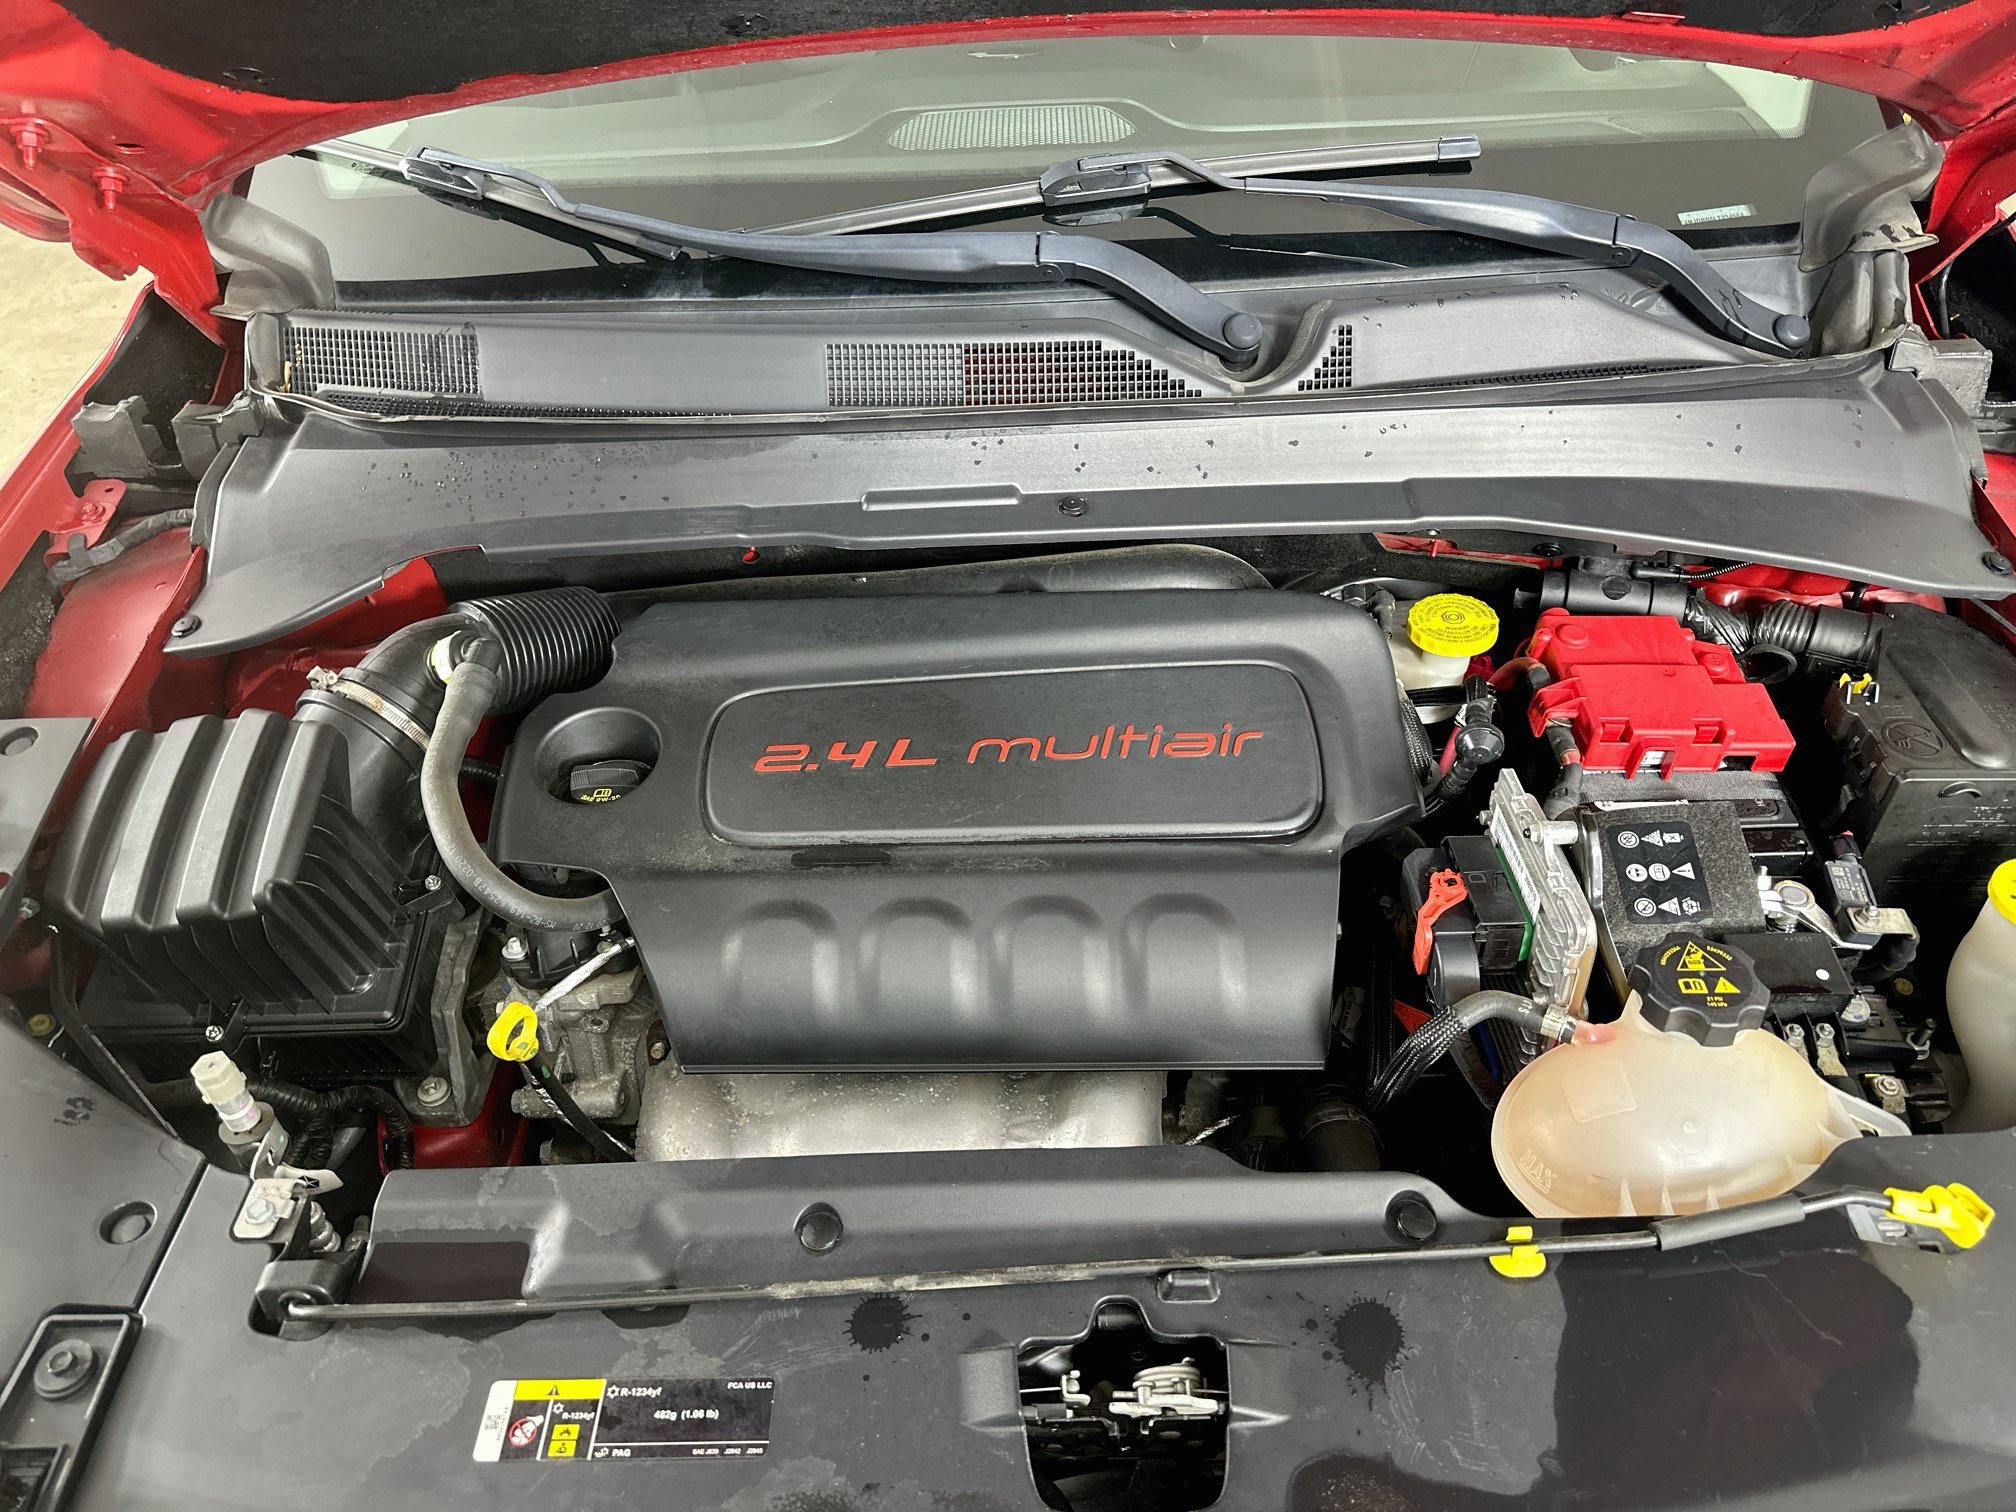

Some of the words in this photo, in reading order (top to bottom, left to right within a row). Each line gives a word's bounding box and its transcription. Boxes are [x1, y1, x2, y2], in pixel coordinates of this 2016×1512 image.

[968, 723, 1264, 763] multiair
[580, 794, 595, 802] SAE
[620, 1386, 662, 1398] R-1234yf
[562, 1411, 595, 1420] R-1234yf
[653, 1409, 677, 1421] 482g
[705, 1409, 719, 1420] lb)
[611, 1448, 632, 1457] PAG
